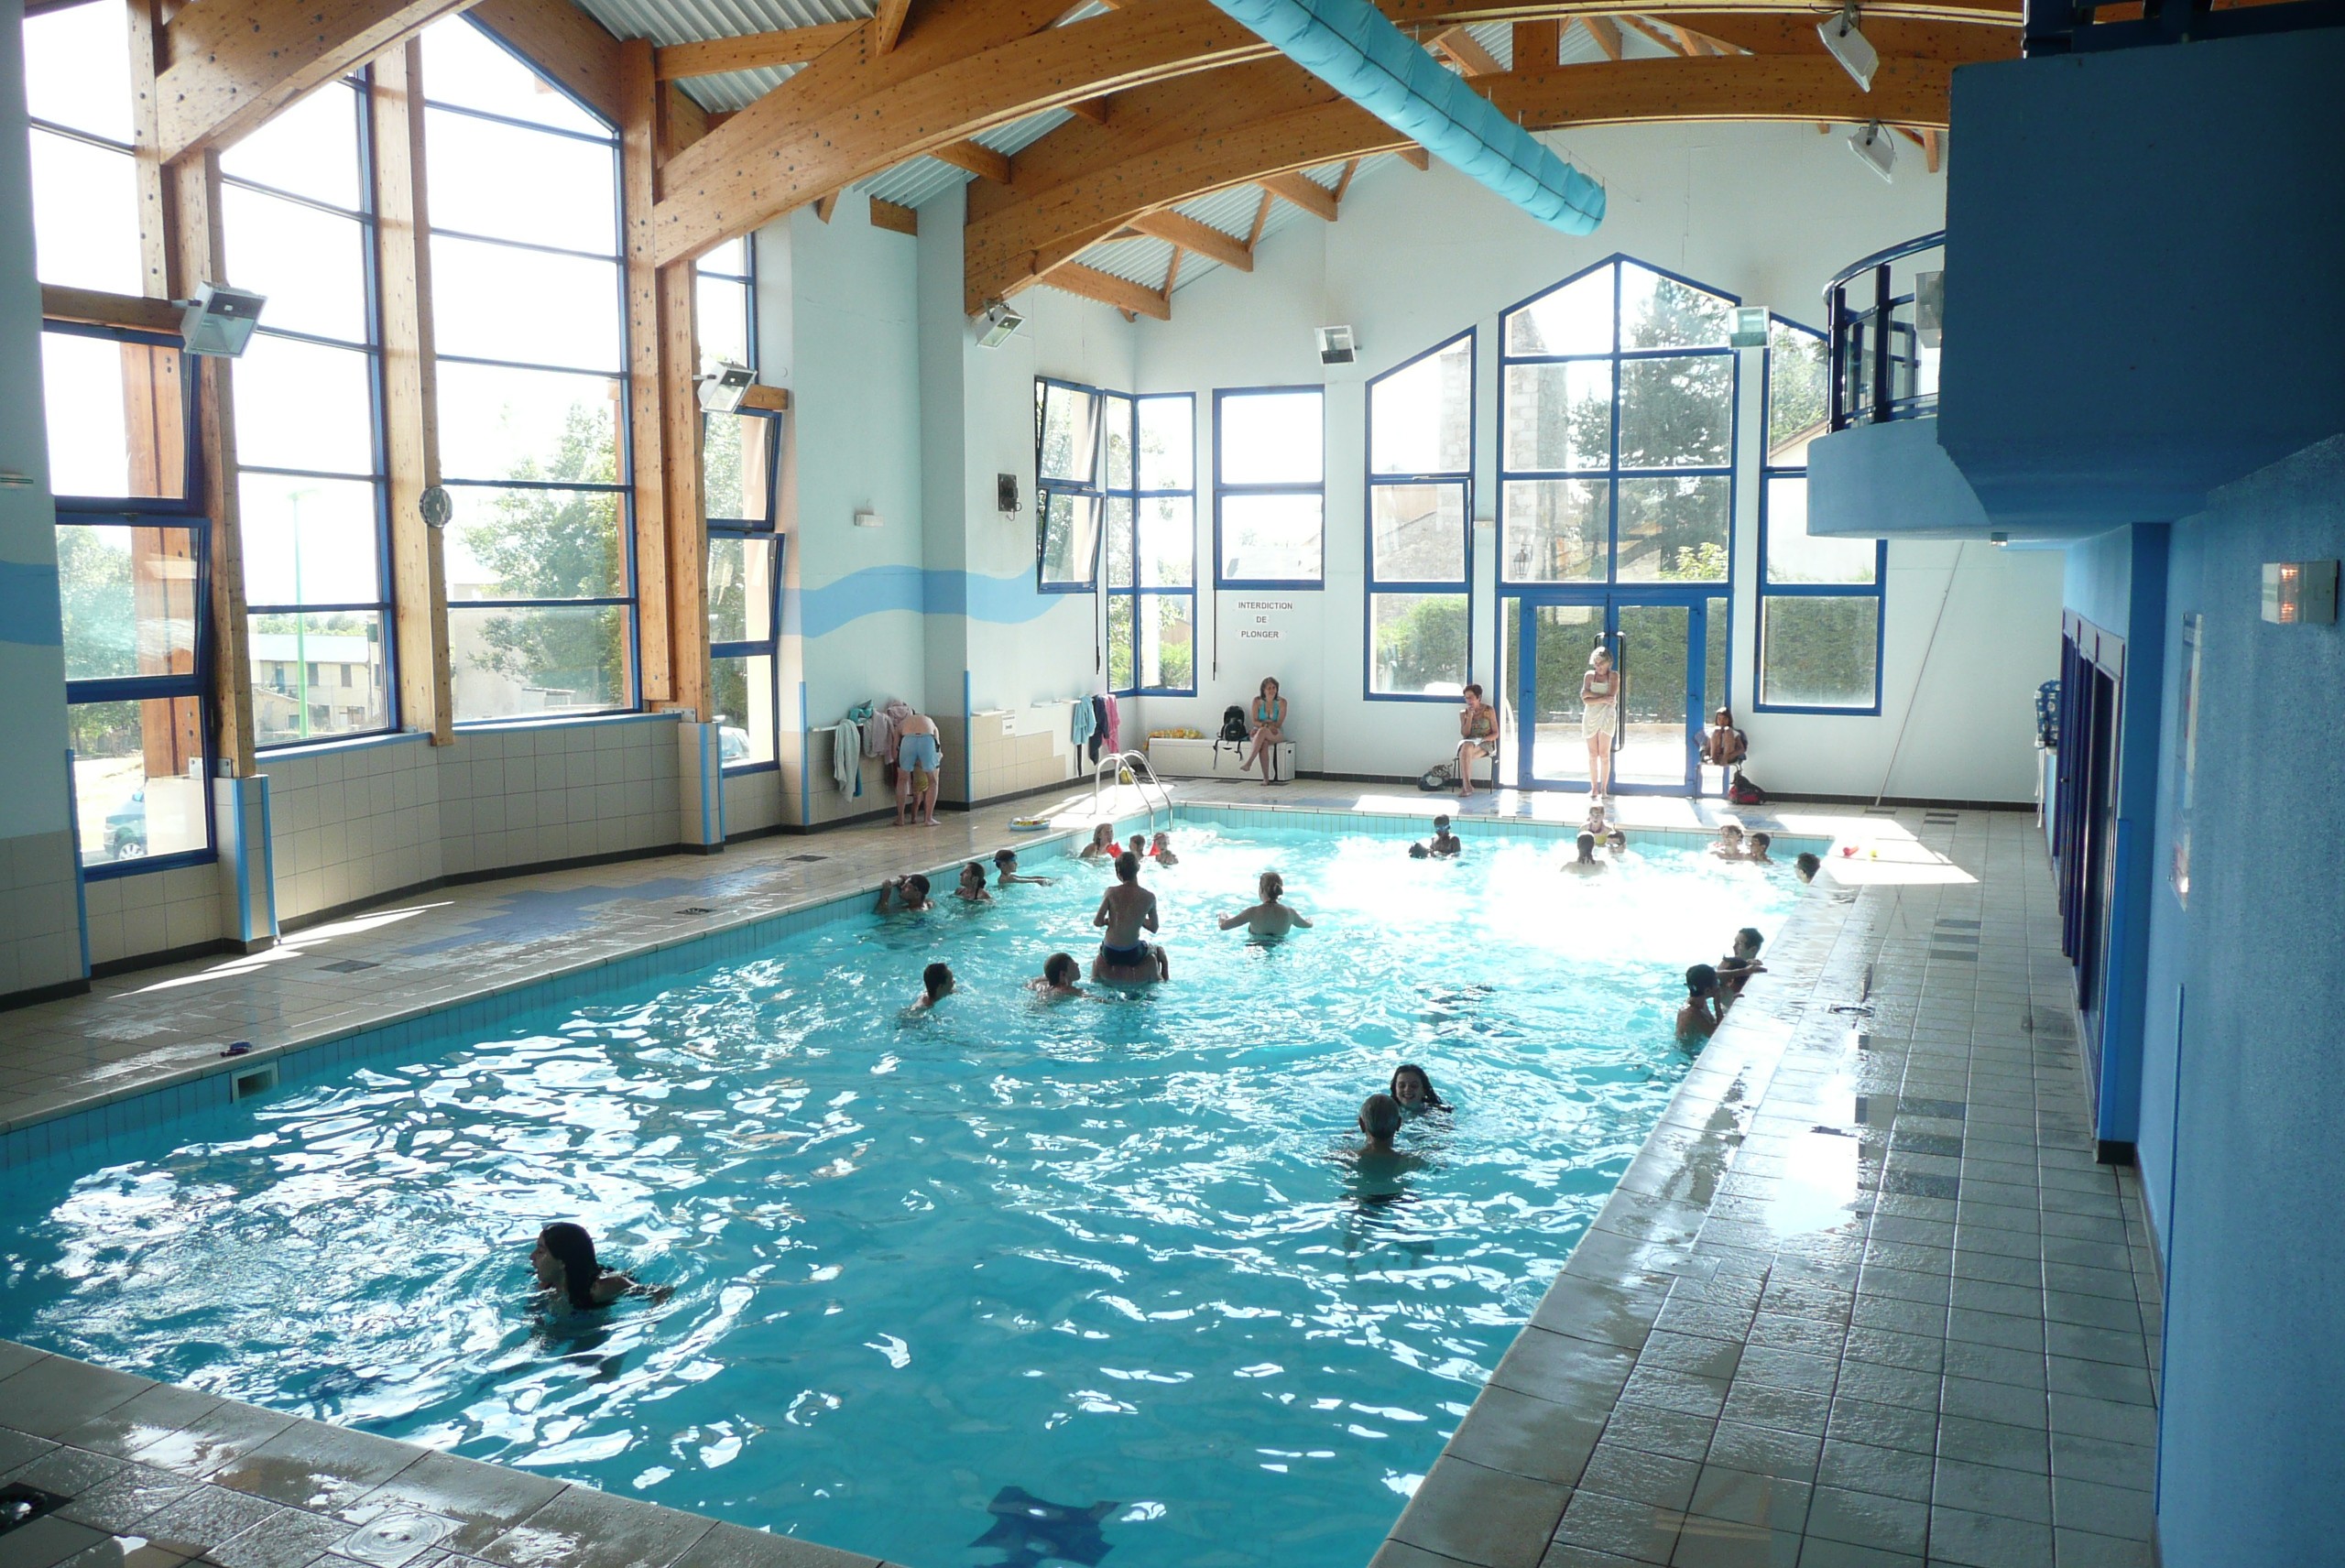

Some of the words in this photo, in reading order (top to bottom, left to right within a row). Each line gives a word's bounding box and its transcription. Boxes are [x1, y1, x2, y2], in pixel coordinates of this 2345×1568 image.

[1238, 602, 1293, 610] INTERDICTION
[1256, 615, 1268, 624] DE
[1240, 630, 1280, 638] PLONGER
